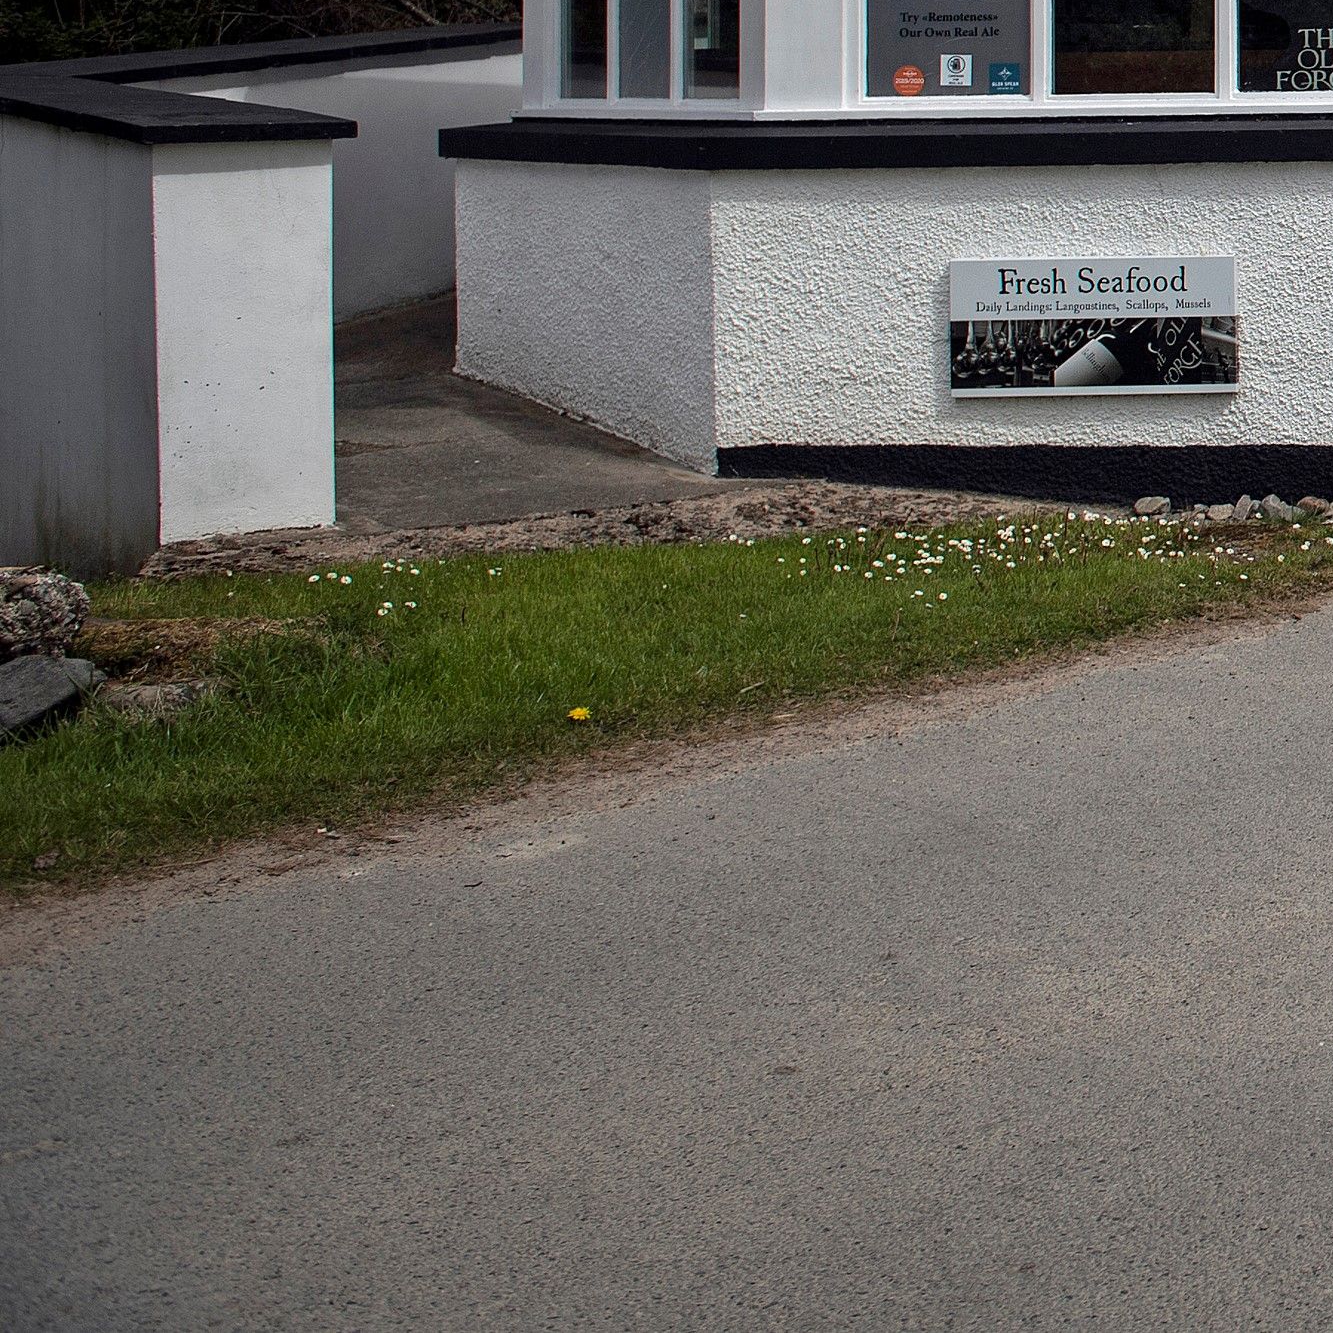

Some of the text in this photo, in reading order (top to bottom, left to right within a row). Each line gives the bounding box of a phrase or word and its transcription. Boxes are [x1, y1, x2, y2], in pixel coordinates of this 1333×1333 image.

[900, 12, 919, 24] Try
[900, 26, 999, 38] Our Own Real Ale
[998, 266, 1188, 294] Fresh Seafood
[976, 298, 1211, 315] Daily Landings: Langoustines, Scallops, Mussels
